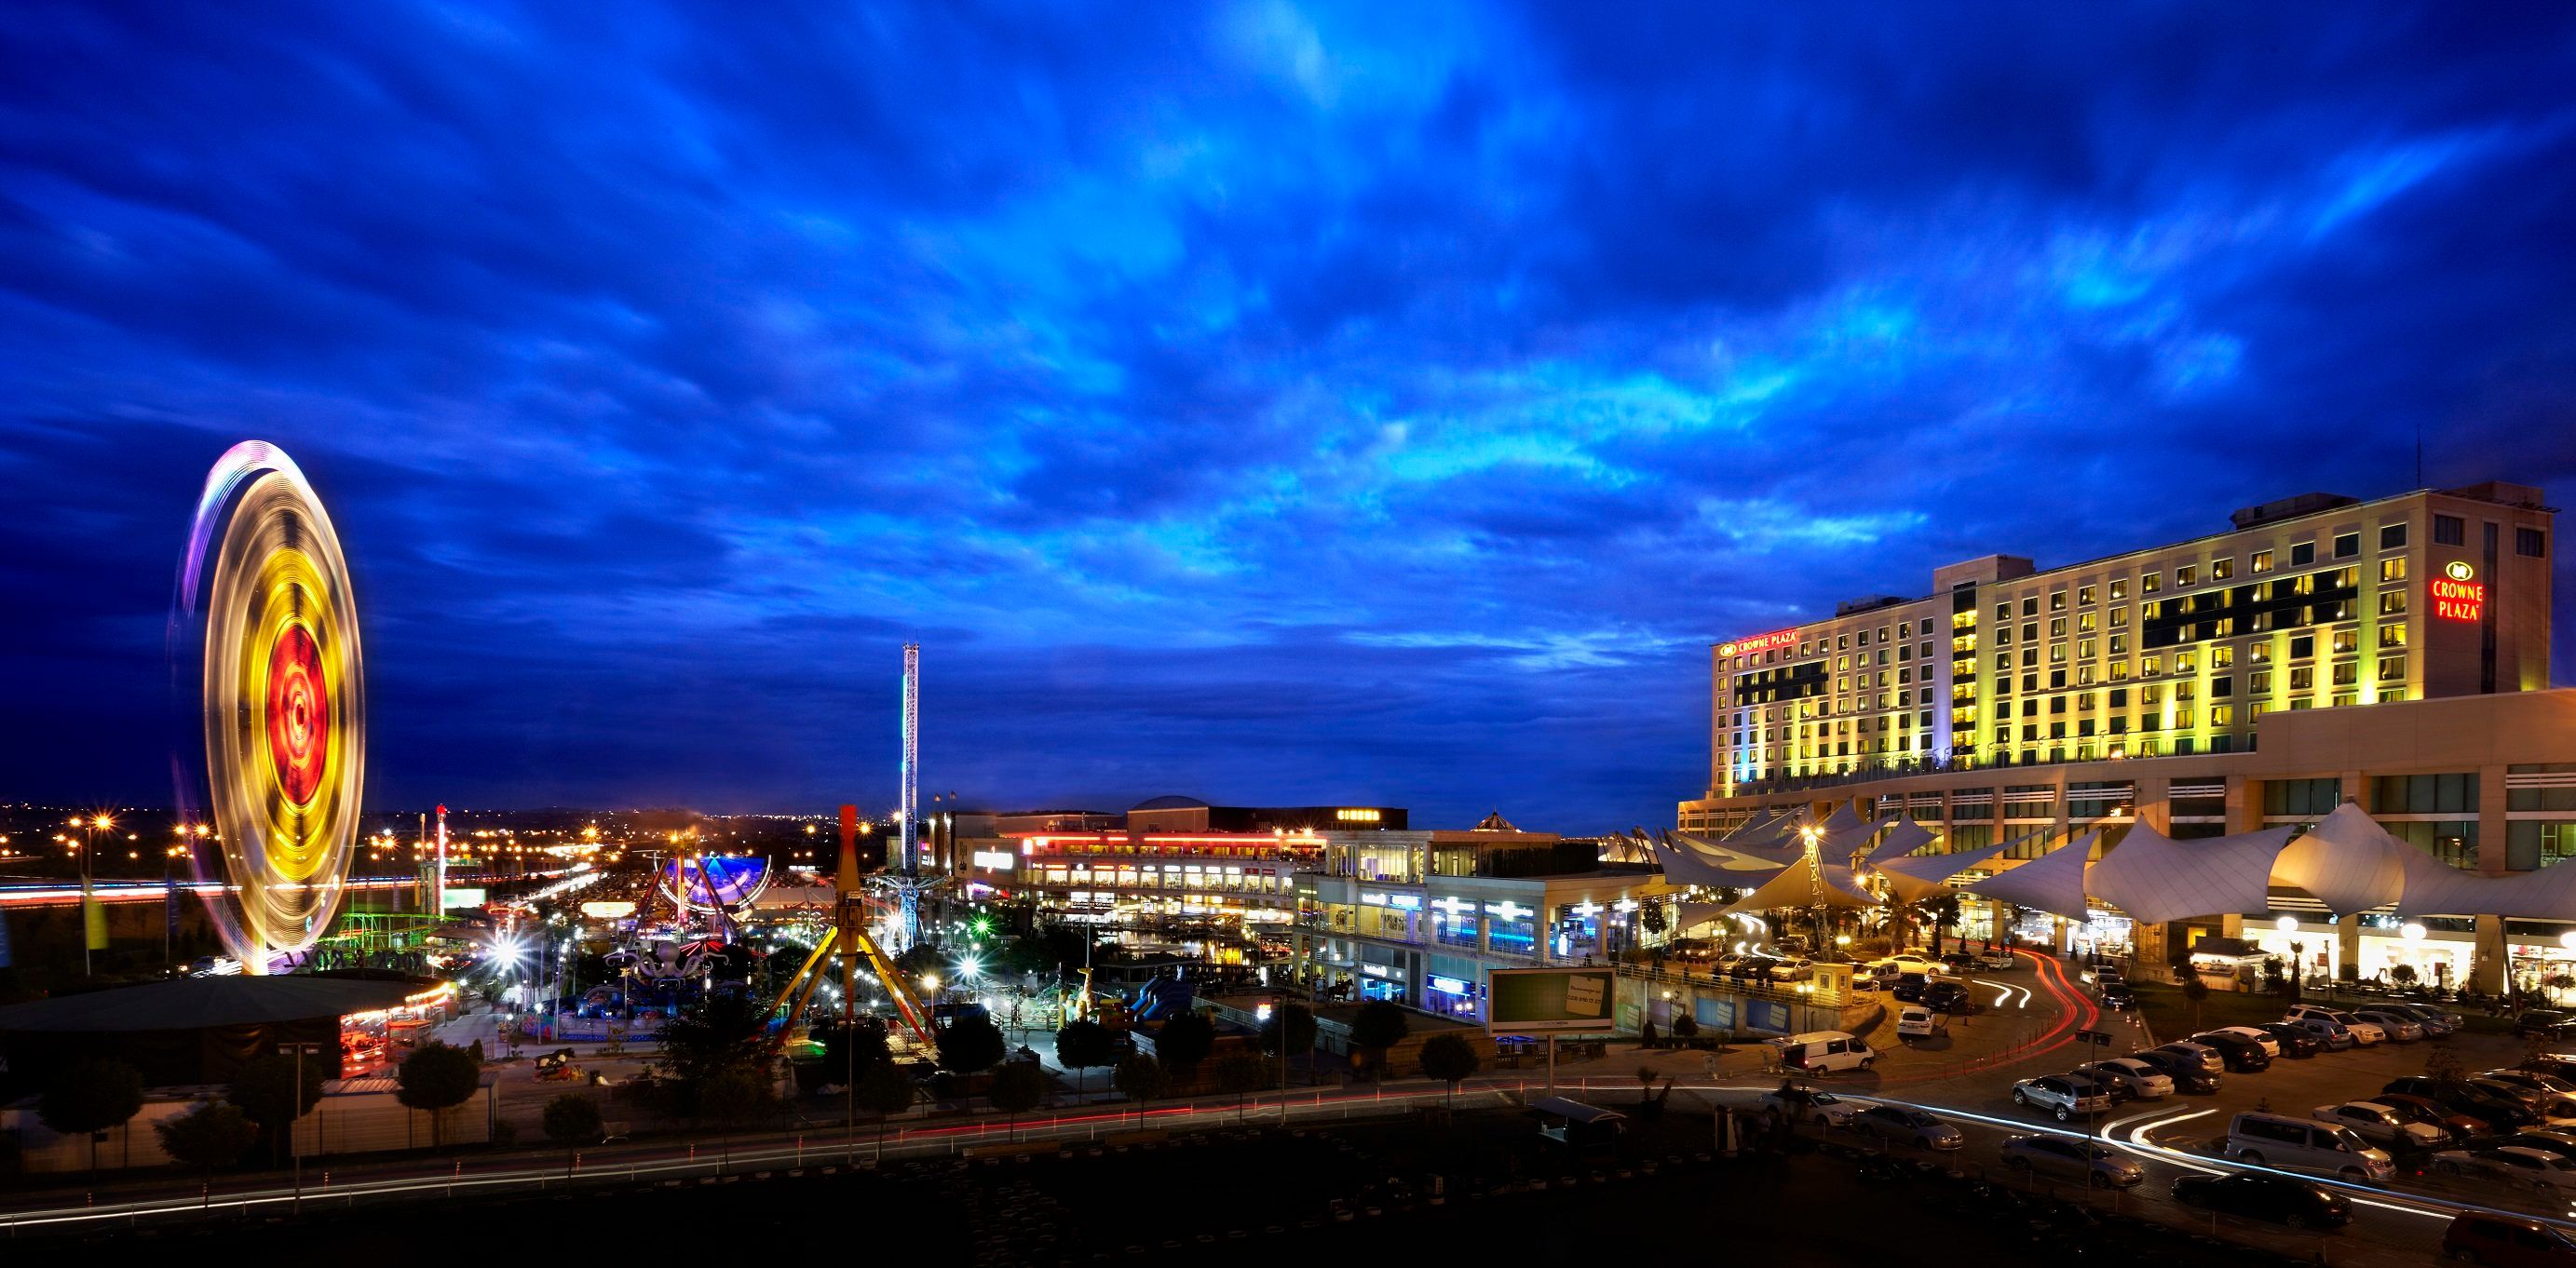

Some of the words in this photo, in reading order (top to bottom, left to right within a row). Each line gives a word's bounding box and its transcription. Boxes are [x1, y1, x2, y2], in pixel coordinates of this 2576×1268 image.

[2433, 580, 2483, 601] CROWNE
[2439, 601, 2478, 620] PLAZA
[1738, 638, 1769, 652] CROWNE
[1770, 632, 1796, 645] PLAZA
